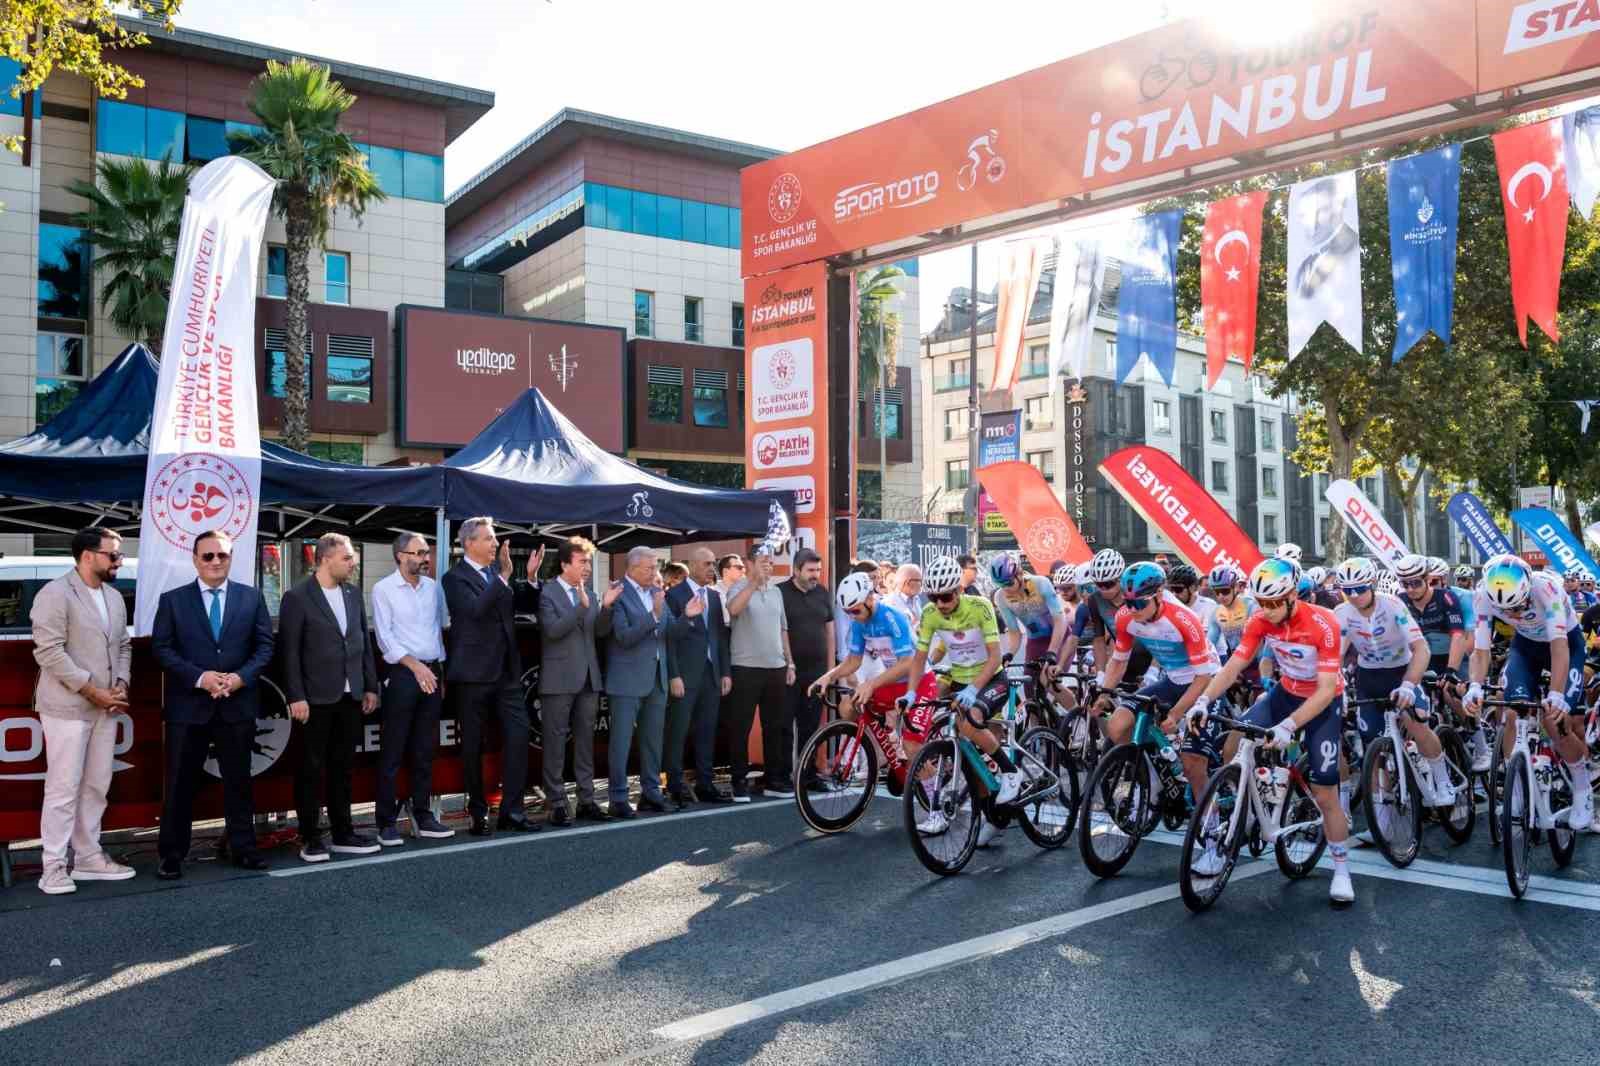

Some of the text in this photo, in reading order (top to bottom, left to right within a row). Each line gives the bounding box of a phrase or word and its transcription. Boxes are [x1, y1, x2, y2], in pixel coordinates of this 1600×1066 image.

[1082, 48, 1387, 179] İSTANBUL
[753, 219, 817, 244] T.C. GENÇLİK VE
[753, 232, 817, 257] SPOR BAKANLIĞI
[752, 295, 816, 324] İSTANBUL
[457, 348, 516, 374] yeditepe
[173, 361, 198, 440] TÜRKİYE
[219, 344, 236, 449] BAKANLIĞI
[800, 390, 809, 399] VE
[758, 405, 774, 416] SPOR
[779, 435, 810, 450] FATİH
[1072, 406, 1084, 466] DOSSO
